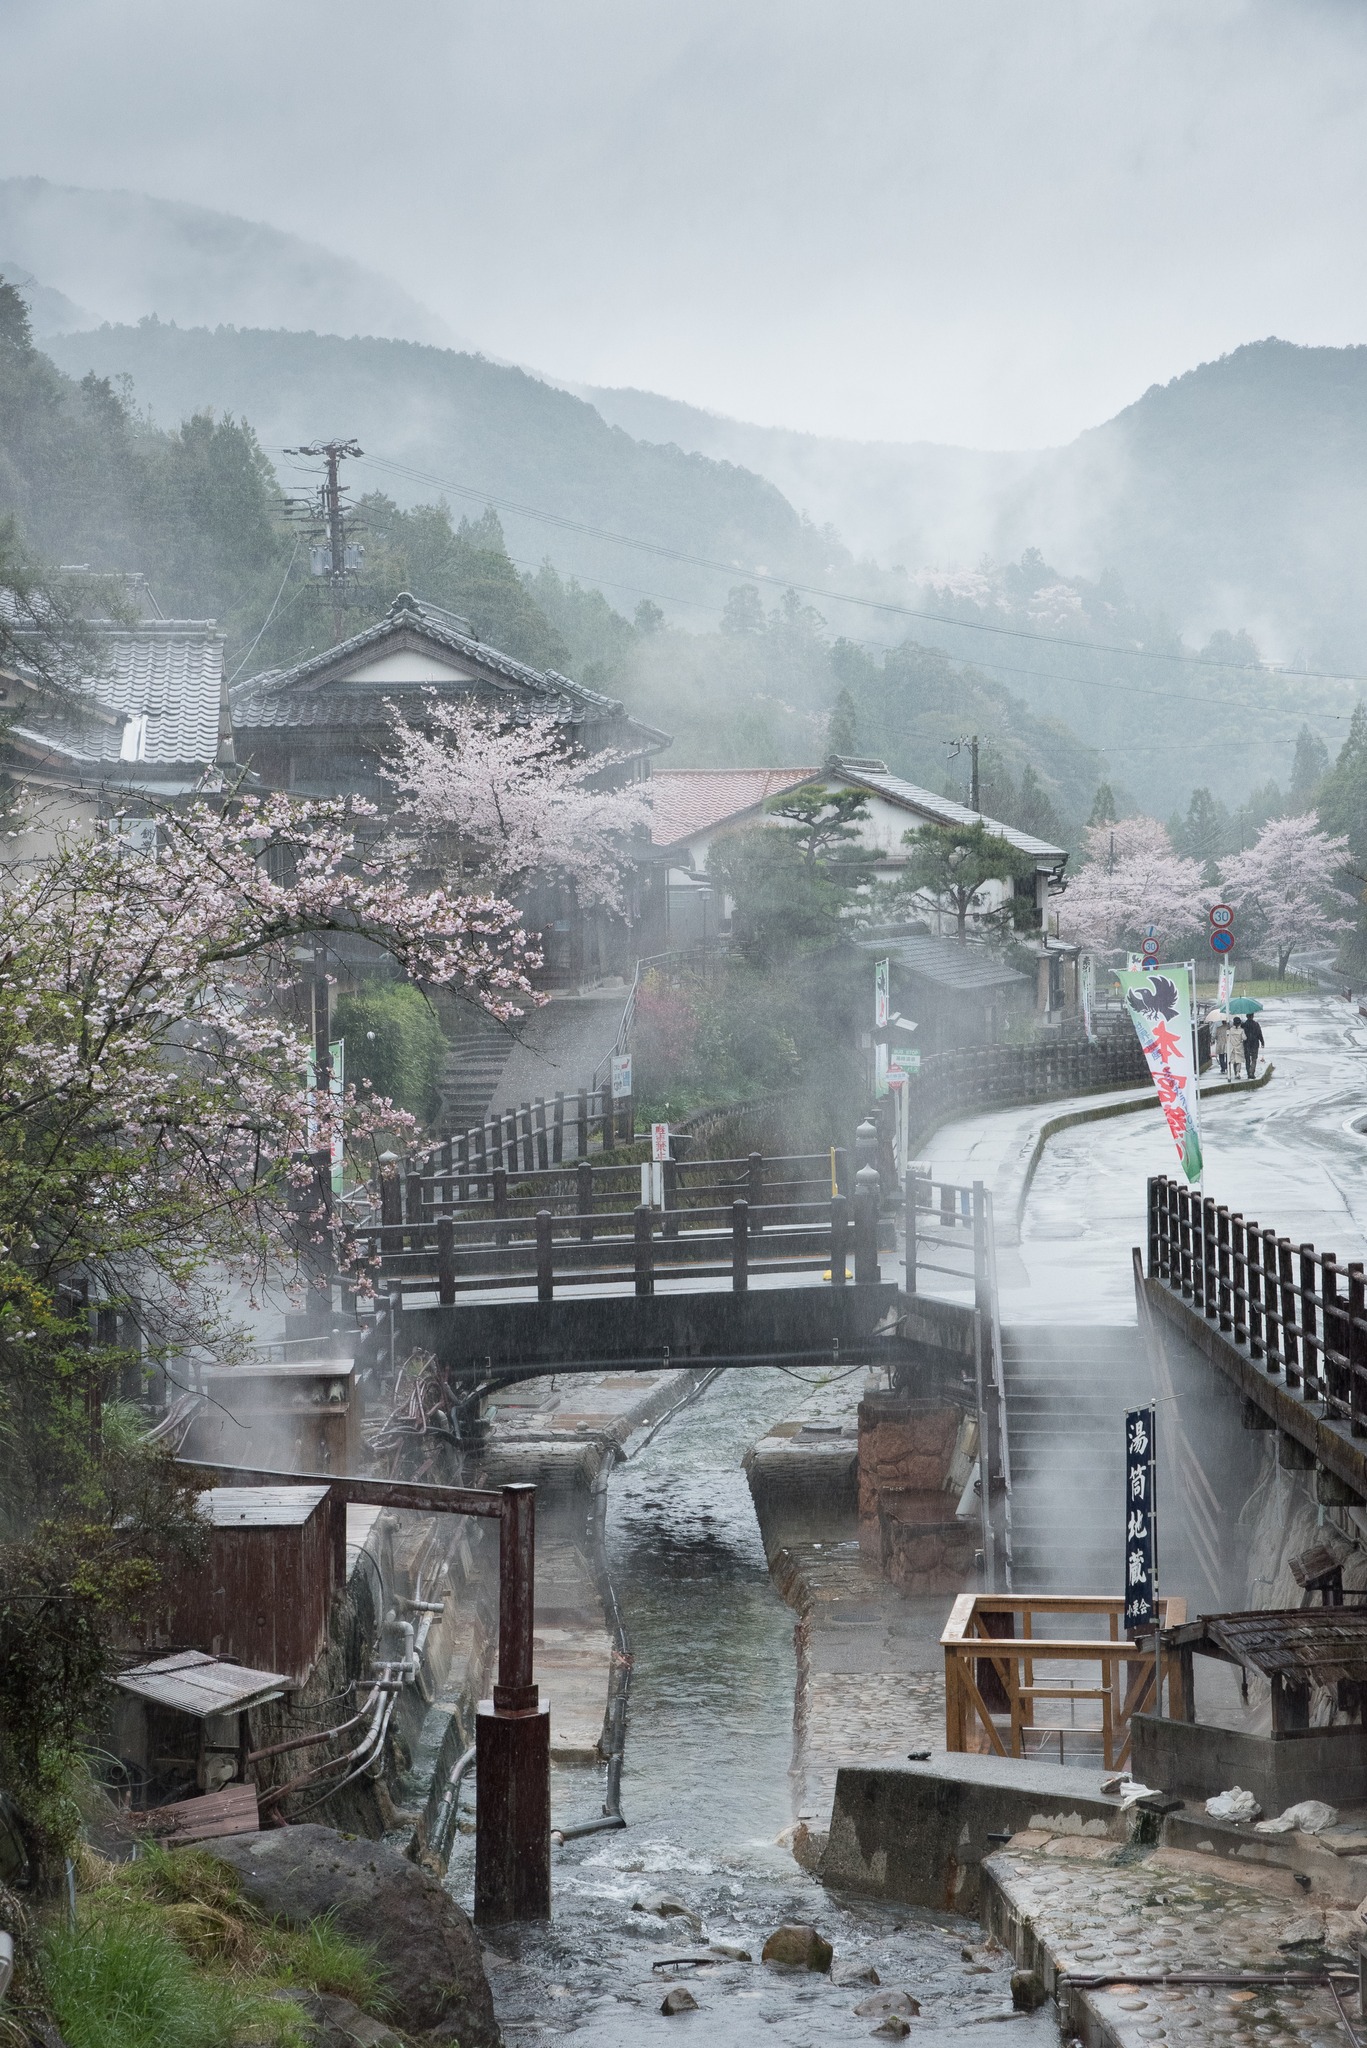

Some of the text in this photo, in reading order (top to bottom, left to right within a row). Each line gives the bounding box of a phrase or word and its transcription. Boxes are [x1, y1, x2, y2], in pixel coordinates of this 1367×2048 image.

[1214, 911, 1229, 922] 30
[1145, 942, 1156, 951] 30
[655, 1123, 667, 1160] 駐車禁止
